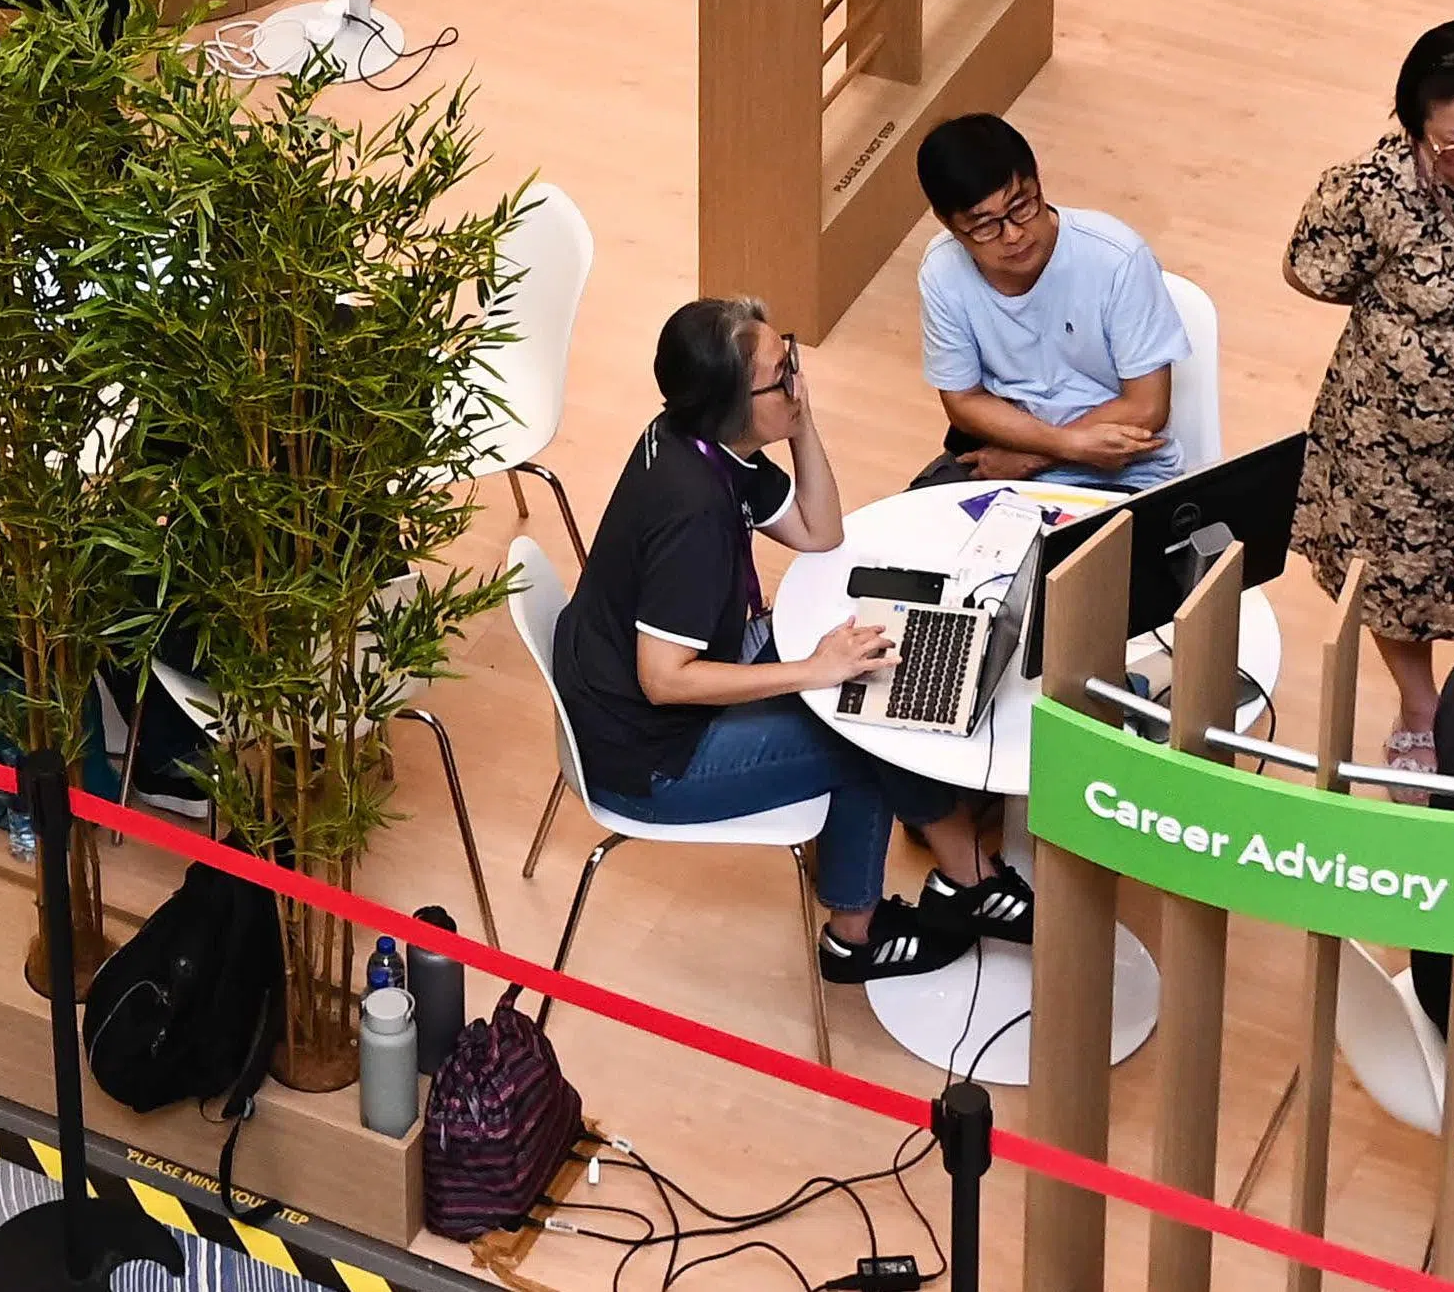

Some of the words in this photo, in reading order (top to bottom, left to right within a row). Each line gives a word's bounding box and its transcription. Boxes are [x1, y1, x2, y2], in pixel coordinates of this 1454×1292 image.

[1083, 780, 1231, 860] Career
[1237, 829, 1450, 913] Advisory
[126, 1147, 184, 1179] PLEASE
[274, 1208, 310, 1226] TEP
